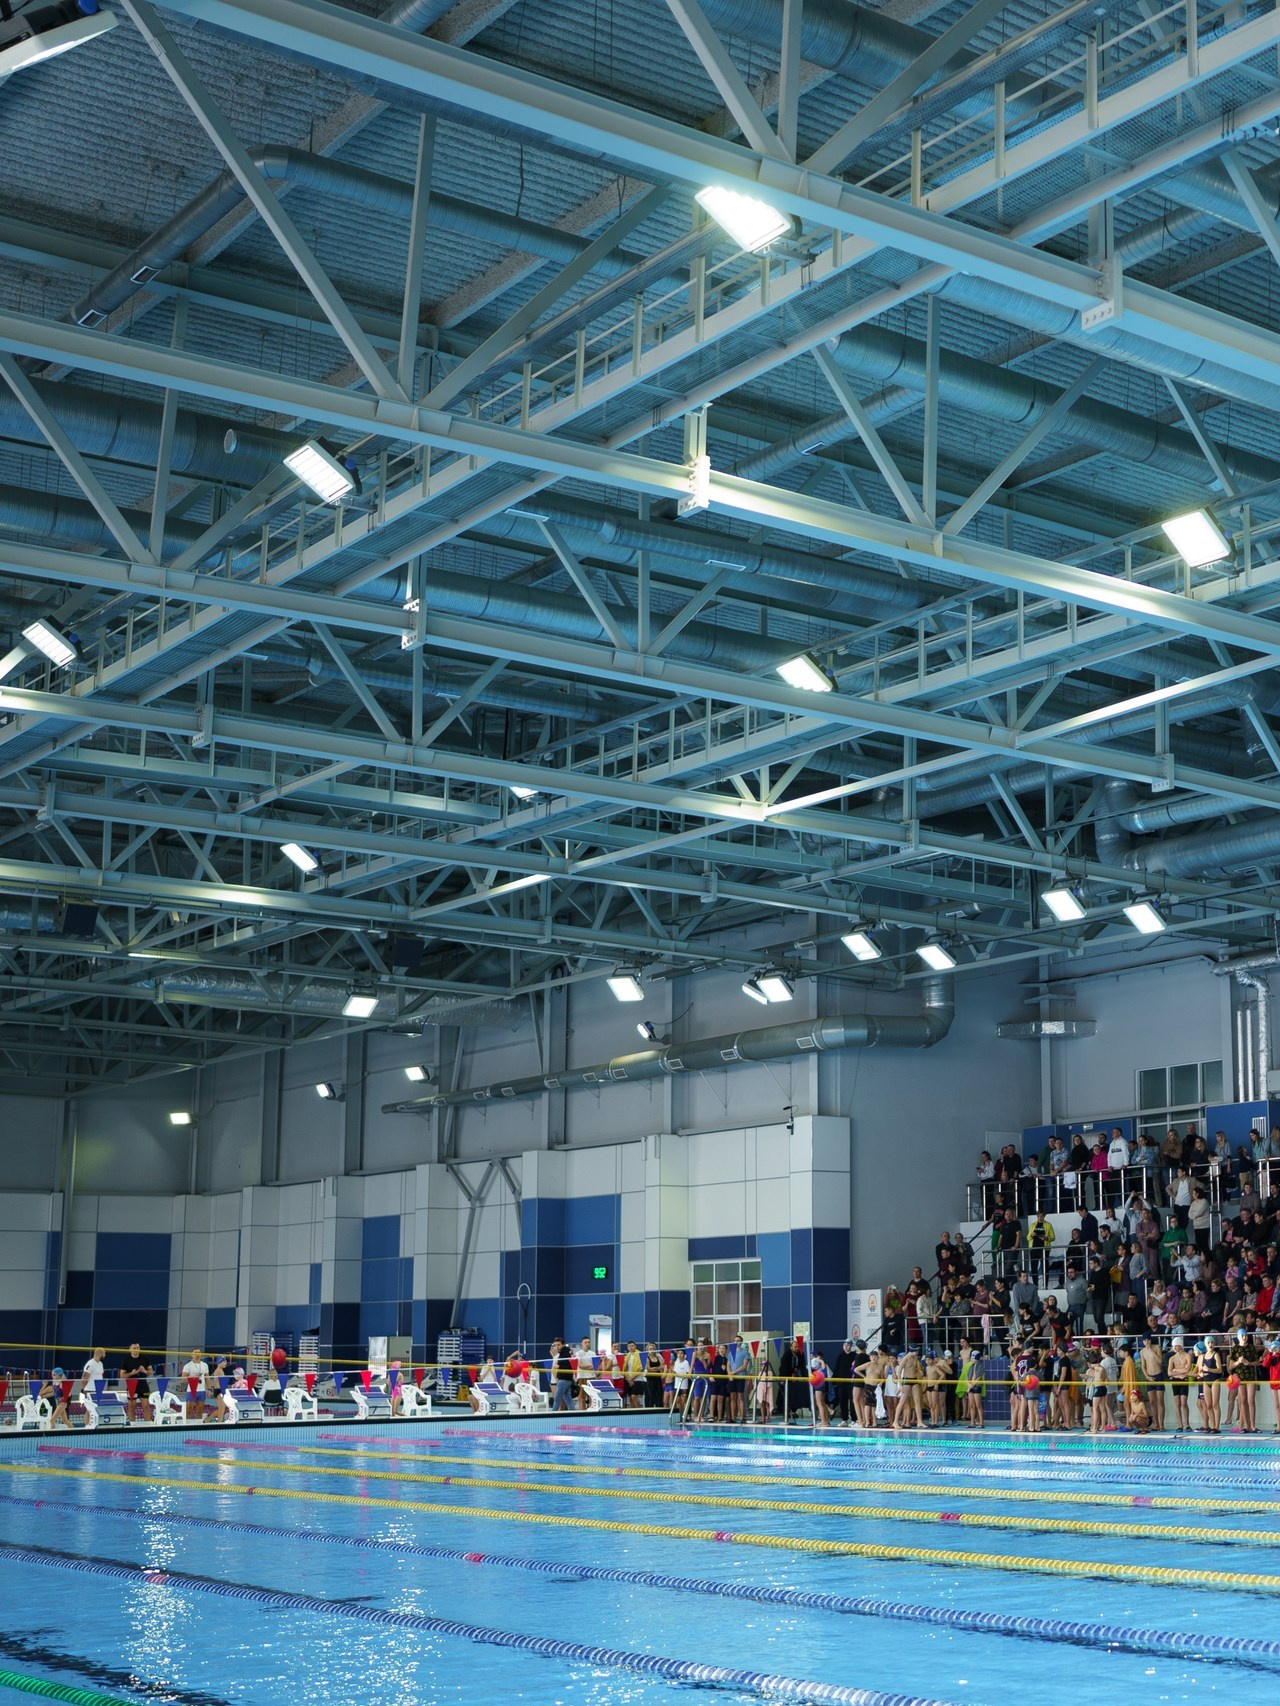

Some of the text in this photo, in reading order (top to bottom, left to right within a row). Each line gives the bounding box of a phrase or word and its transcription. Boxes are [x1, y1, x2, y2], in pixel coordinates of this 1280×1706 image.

[371, 1406, 378, 1414] 7
[490, 1402, 497, 1410] 8
[242, 1409, 249, 1418] 6
[103, 1414, 111, 1423] 5
